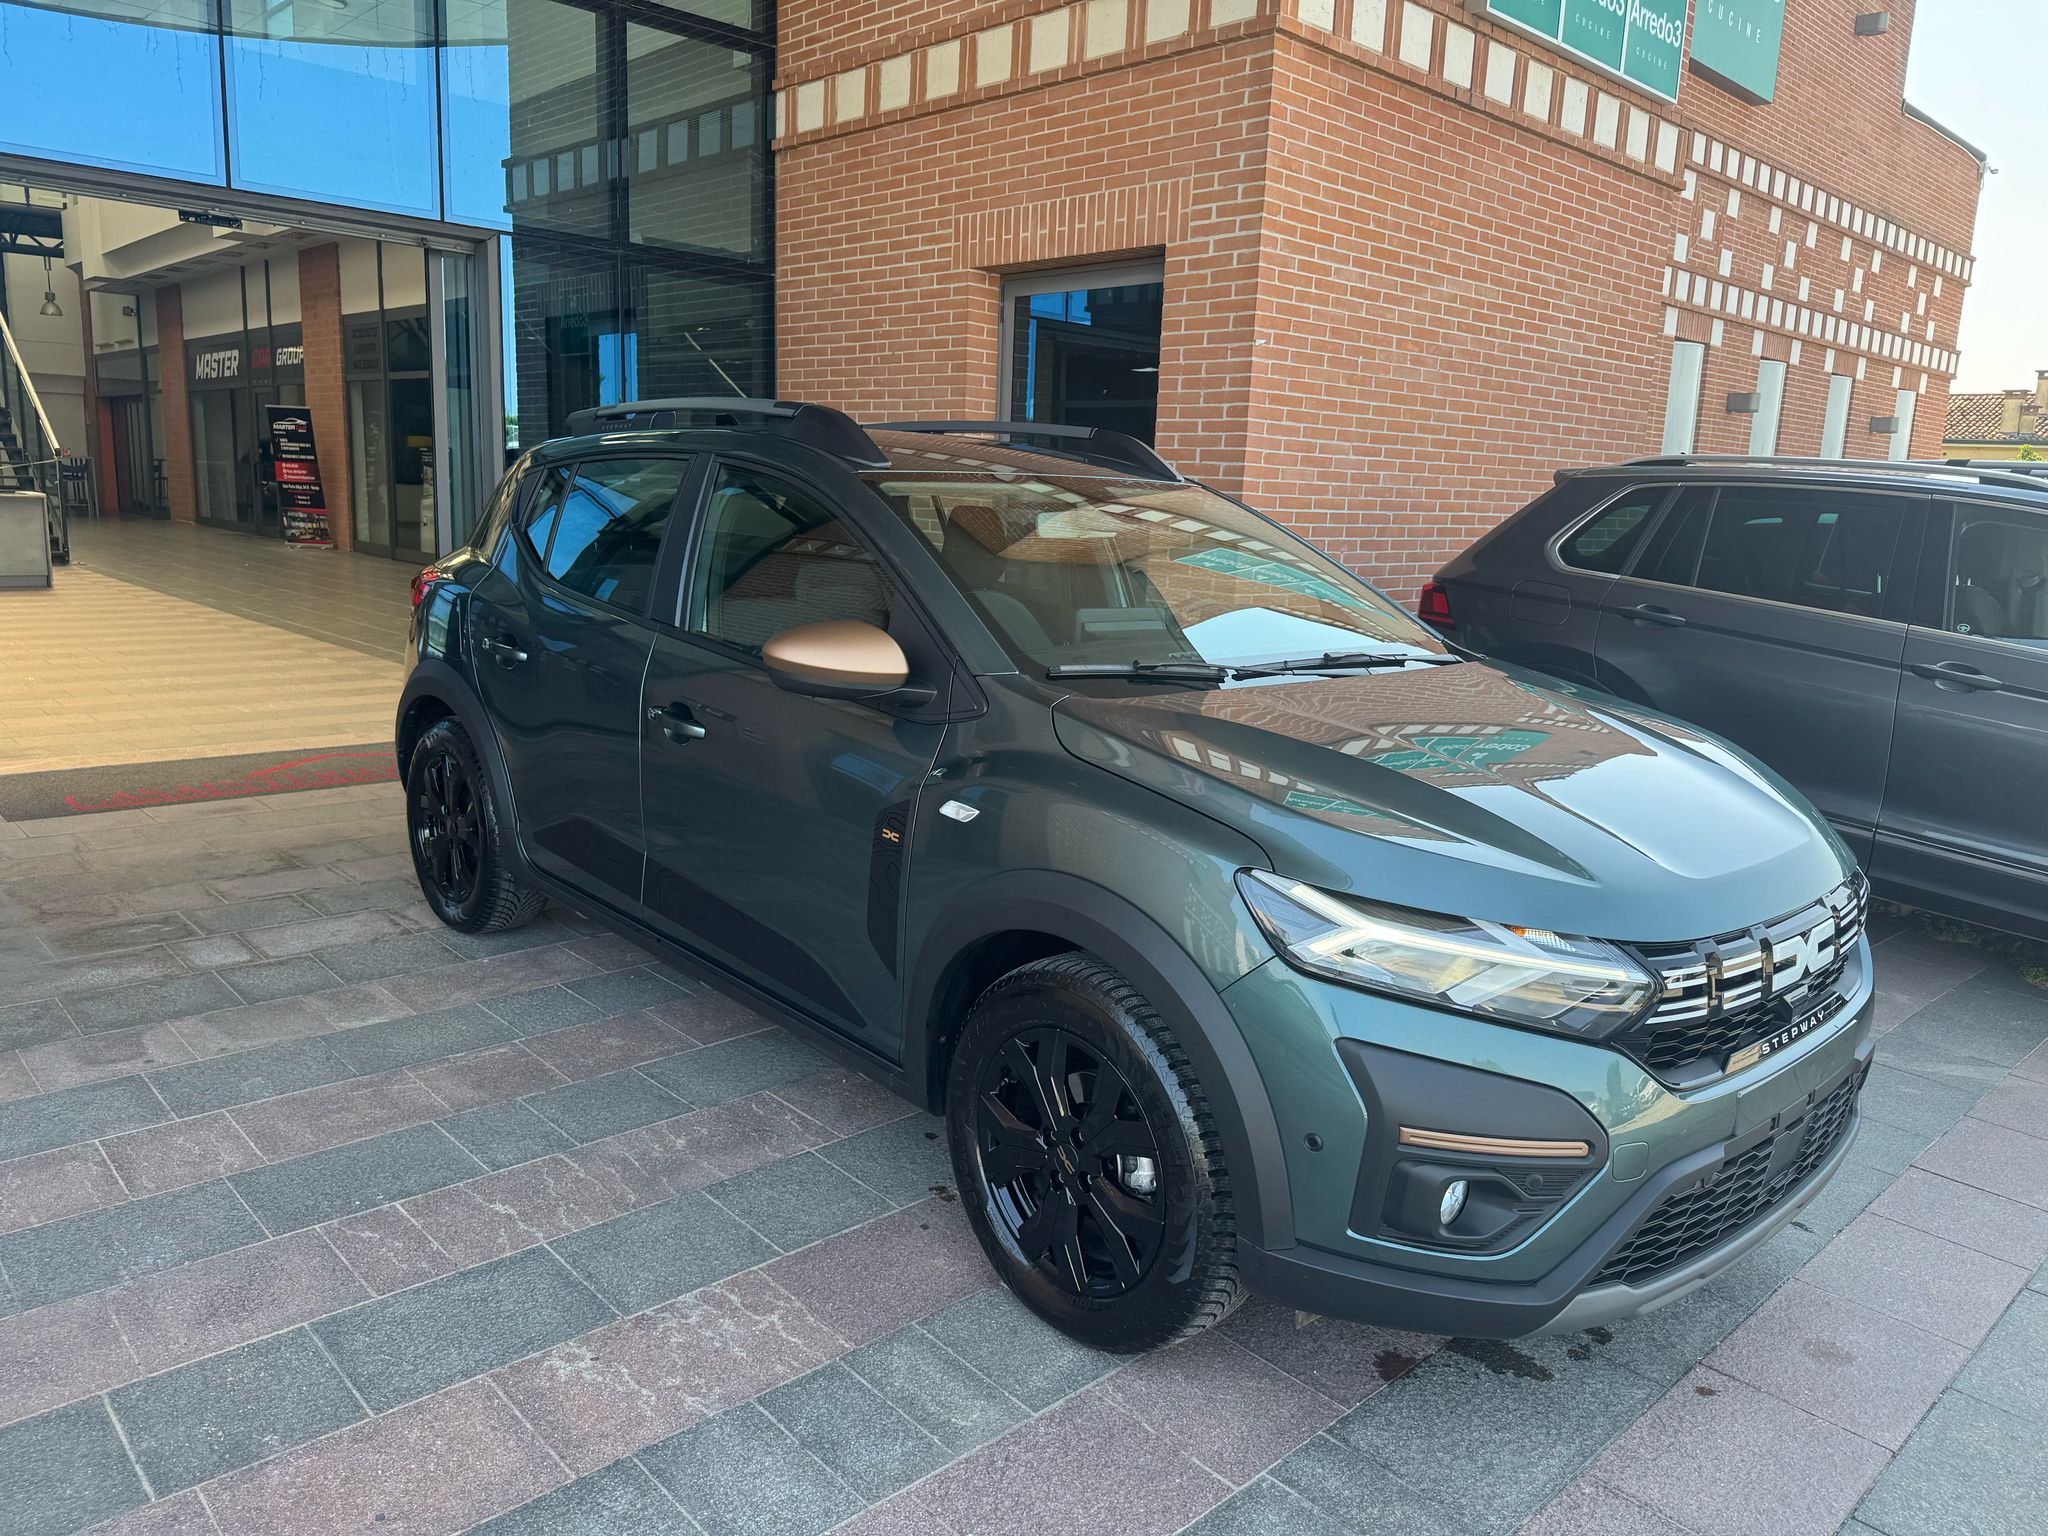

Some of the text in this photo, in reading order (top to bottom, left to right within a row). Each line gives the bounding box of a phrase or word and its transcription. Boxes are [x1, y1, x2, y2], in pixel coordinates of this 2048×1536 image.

[1630, 0, 1682, 48] Arredo3
[1707, 0, 1761, 44] CUCINE
[195, 349, 239, 380] MASTER
[1762, 1009, 1826, 1055] STEPWAY
